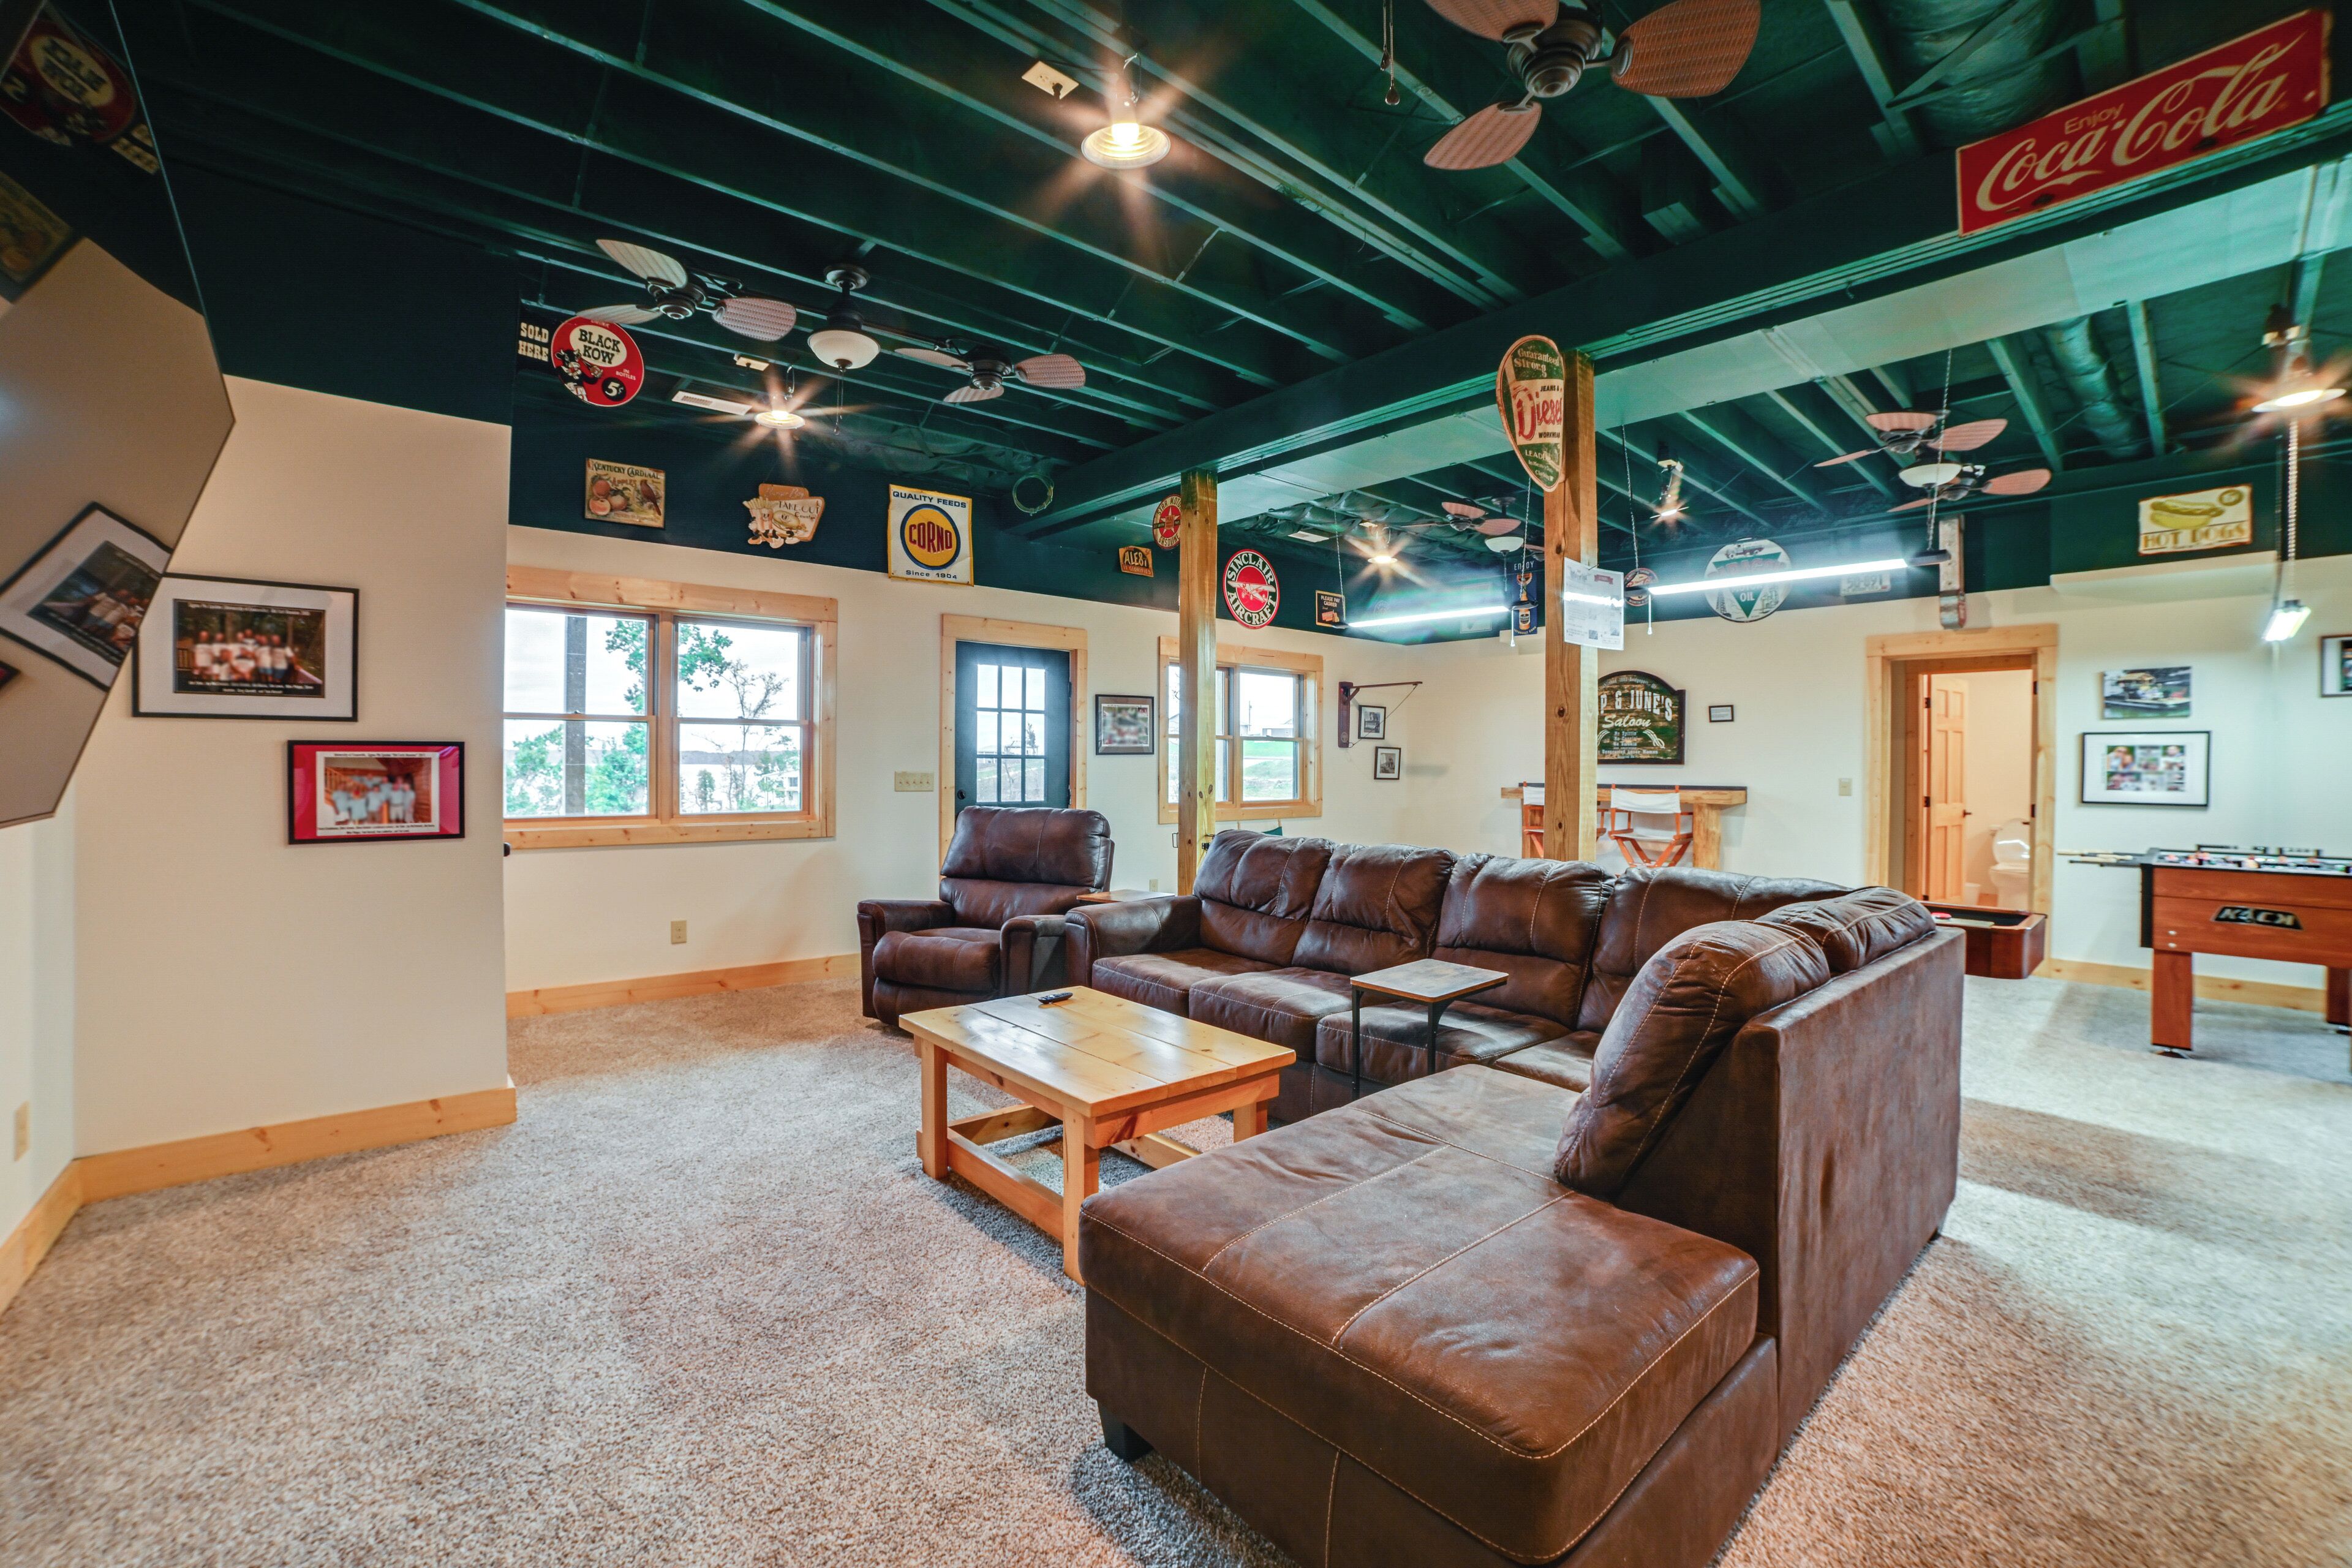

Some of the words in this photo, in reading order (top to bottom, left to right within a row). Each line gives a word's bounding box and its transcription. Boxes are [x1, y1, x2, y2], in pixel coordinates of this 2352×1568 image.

[1975, 30, 2309, 211] Coca-Cola
[2065, 103, 2124, 135] Enjoy
[521, 322, 549, 344] SOLD
[578, 328, 621, 353] BLACK
[518, 340, 549, 362] HERE
[583, 344, 615, 364] KOW
[1517, 348, 1560, 367] Guaranteed
[615, 371, 637, 381] BOTTLES
[1513, 358, 1547, 378] Strong
[592, 461, 626, 474] KENTUCKY
[627, 467, 660, 480] CARDINAL
[778, 501, 820, 514] TAKE-OUT
[892, 491, 933, 503] QUALITY
[937, 499, 967, 508] FEEDS
[1157, 500, 1168, 516] STAR
[1170, 496, 1182, 510] MOTO
[909, 521, 953, 553] CORNO
[1158, 533, 1181, 547] GASOLINE
[2143, 531, 2181, 549] HOT
[2190, 522, 2246, 544] DOGS
[1227, 553, 1275, 584] SINCLAIR
[1513, 560, 1534, 571] ENOY
[1740, 592, 1755, 602] OIL
[1227, 591, 1276, 625] AIRCRAFT
[1615, 690, 1623, 710] &
[1629, 689, 1673, 722] JUNE'S
[1602, 714, 1652, 728] Saloon
